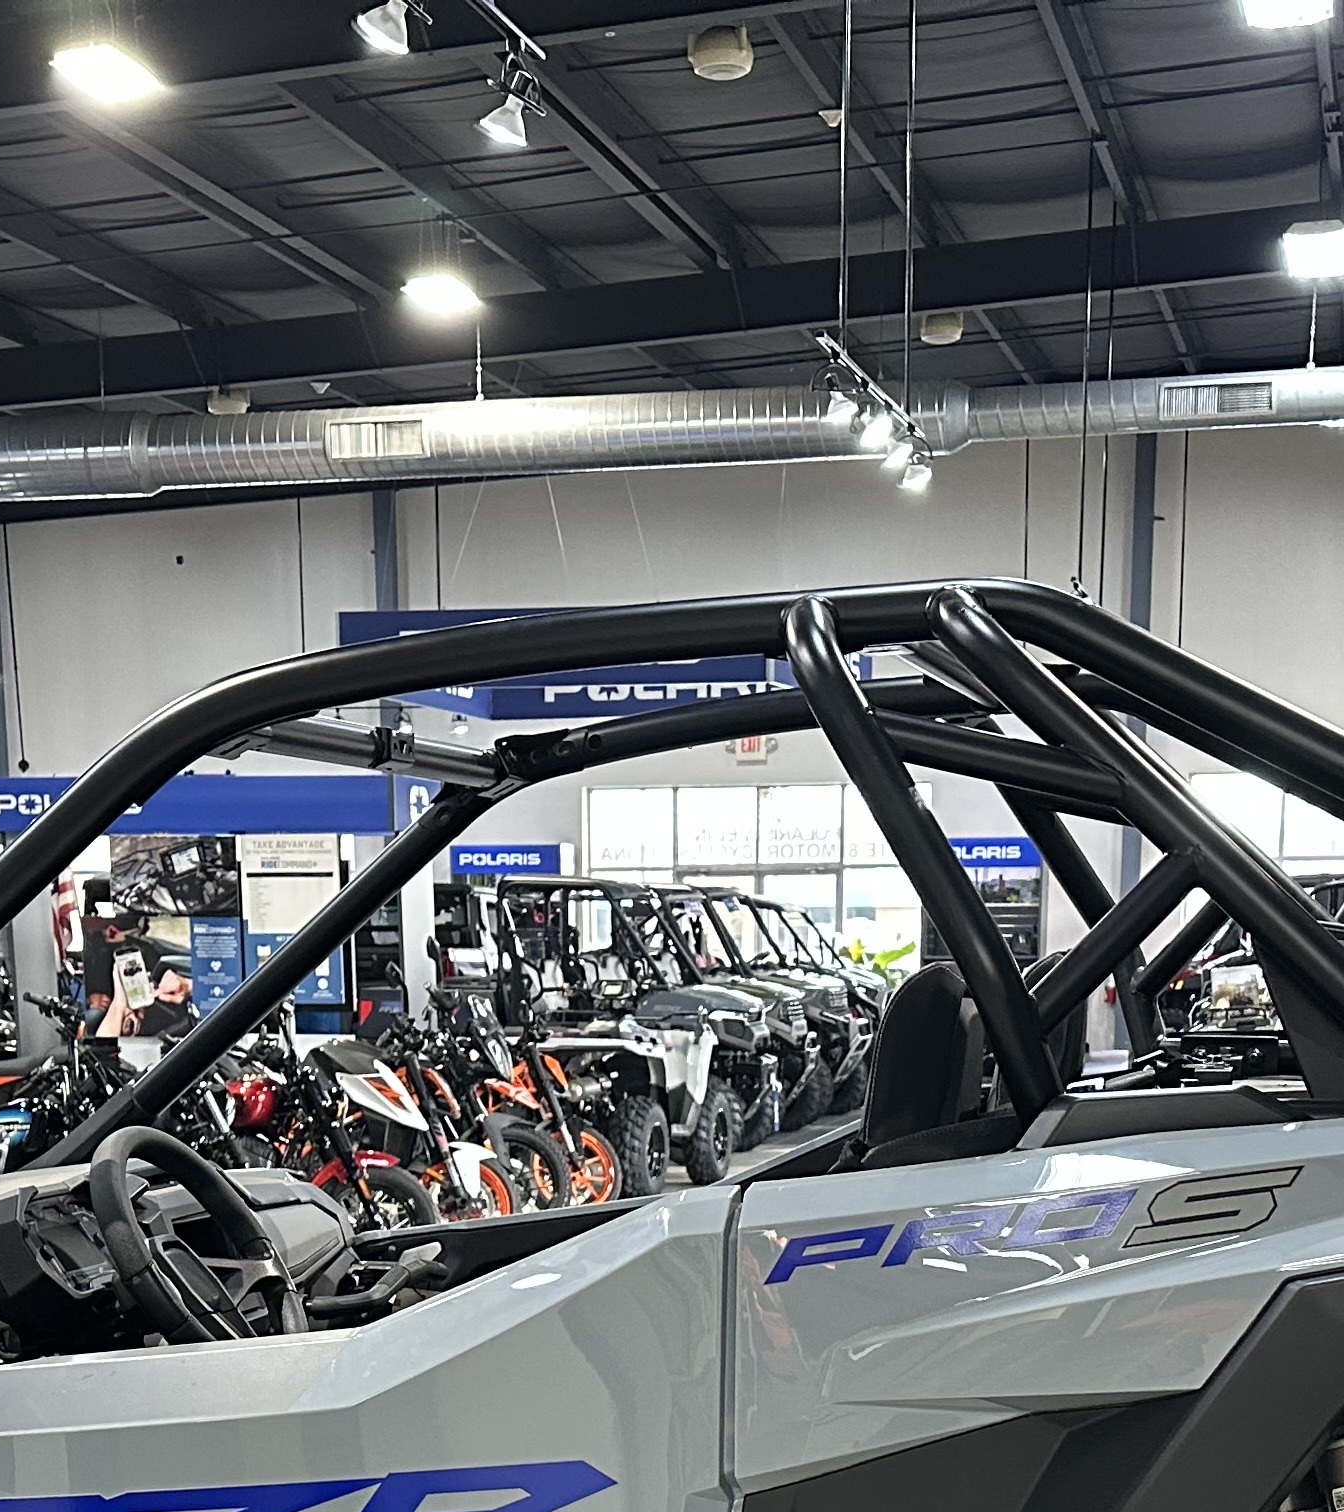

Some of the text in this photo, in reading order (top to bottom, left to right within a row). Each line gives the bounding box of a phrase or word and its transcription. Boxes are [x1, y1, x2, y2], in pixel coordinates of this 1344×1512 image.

[252, 840, 325, 849] TAKE ADVANTAGE
[458, 852, 541, 867] POLARIS
[764, 1165, 1305, 1285] PRO S
